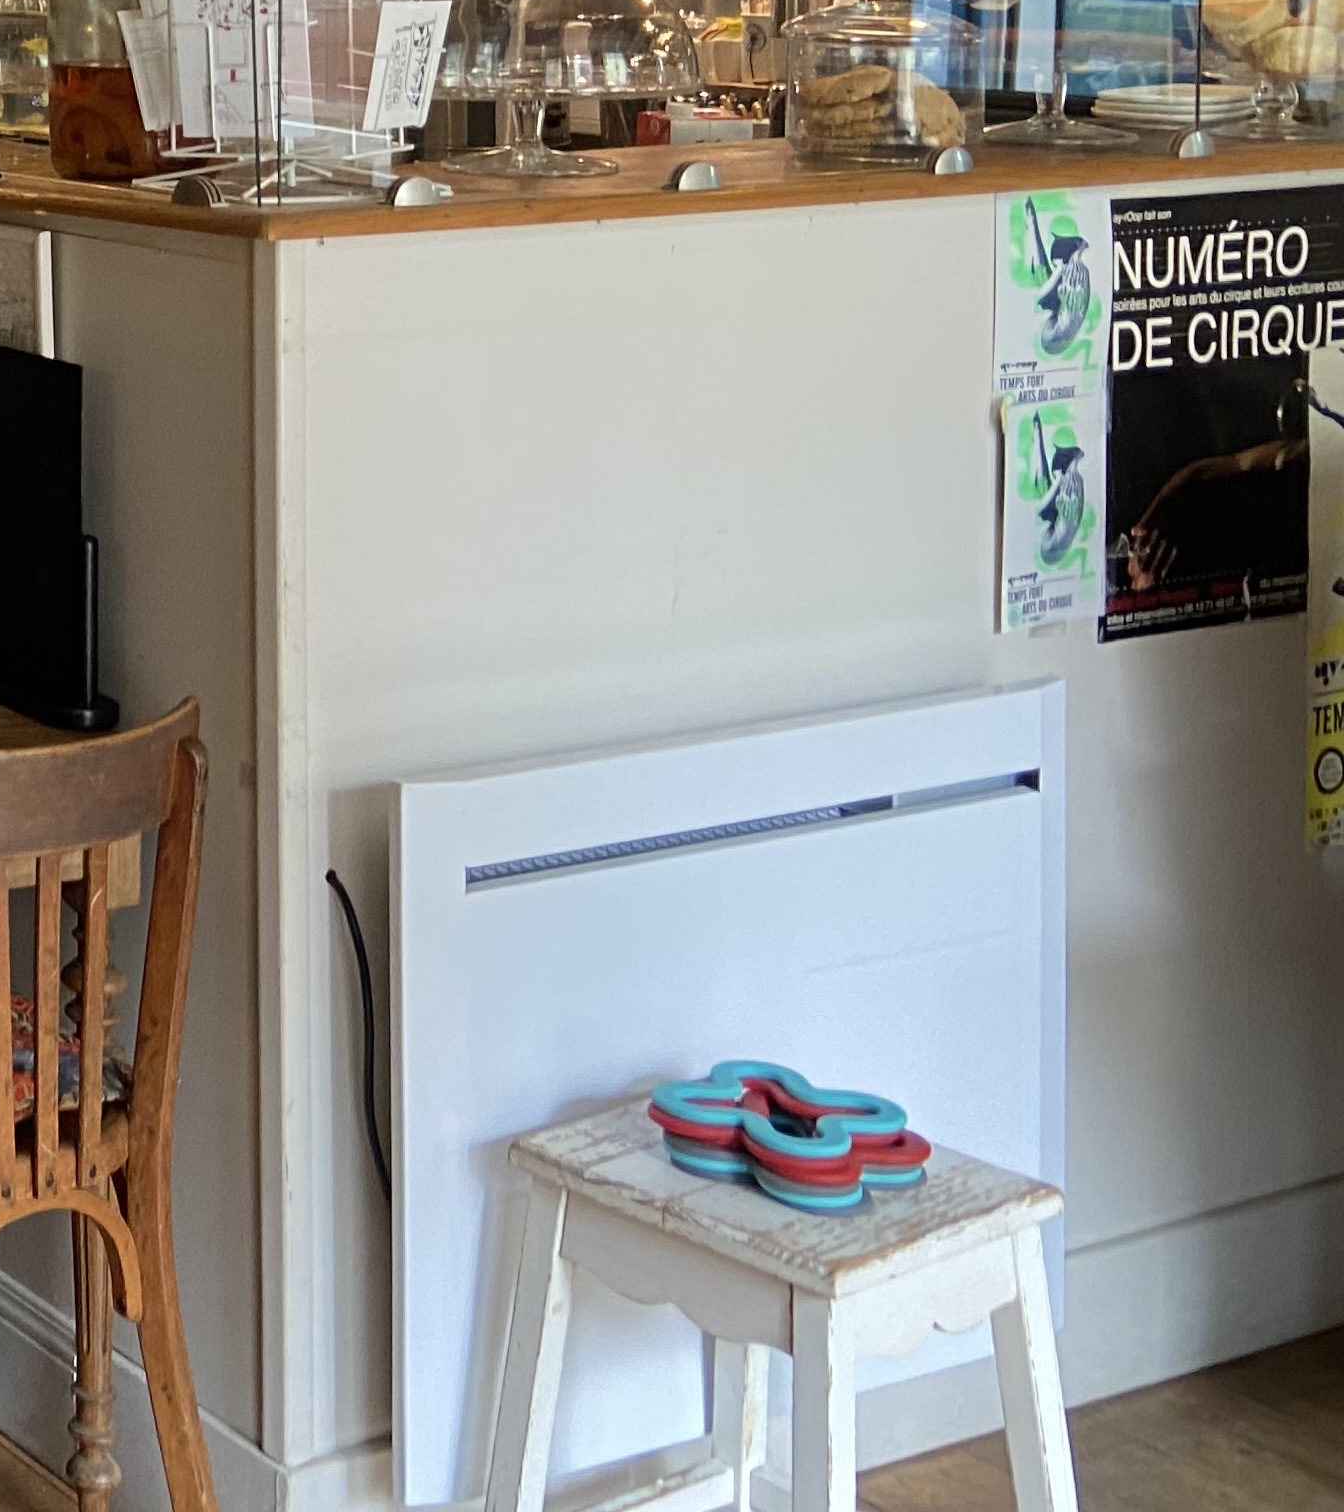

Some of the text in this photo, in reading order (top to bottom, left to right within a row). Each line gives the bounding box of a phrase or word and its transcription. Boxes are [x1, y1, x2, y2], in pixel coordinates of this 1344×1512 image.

[1113, 219, 1309, 291] NUMÉRO
[1113, 296, 1147, 312] soirées
[1149, 295, 1171, 311] pour
[1173, 294, 1187, 305] les
[1210, 291, 1222, 303] du
[1223, 290, 1252, 304] cirque
[1253, 288, 1263, 300] et
[1113, 299, 1344, 372] DE CIRQUE
[1000, 374, 1044, 390] TEMPS FORT
[1018, 390, 1036, 403] ARTS
[1038, 389, 1048, 402] DU
